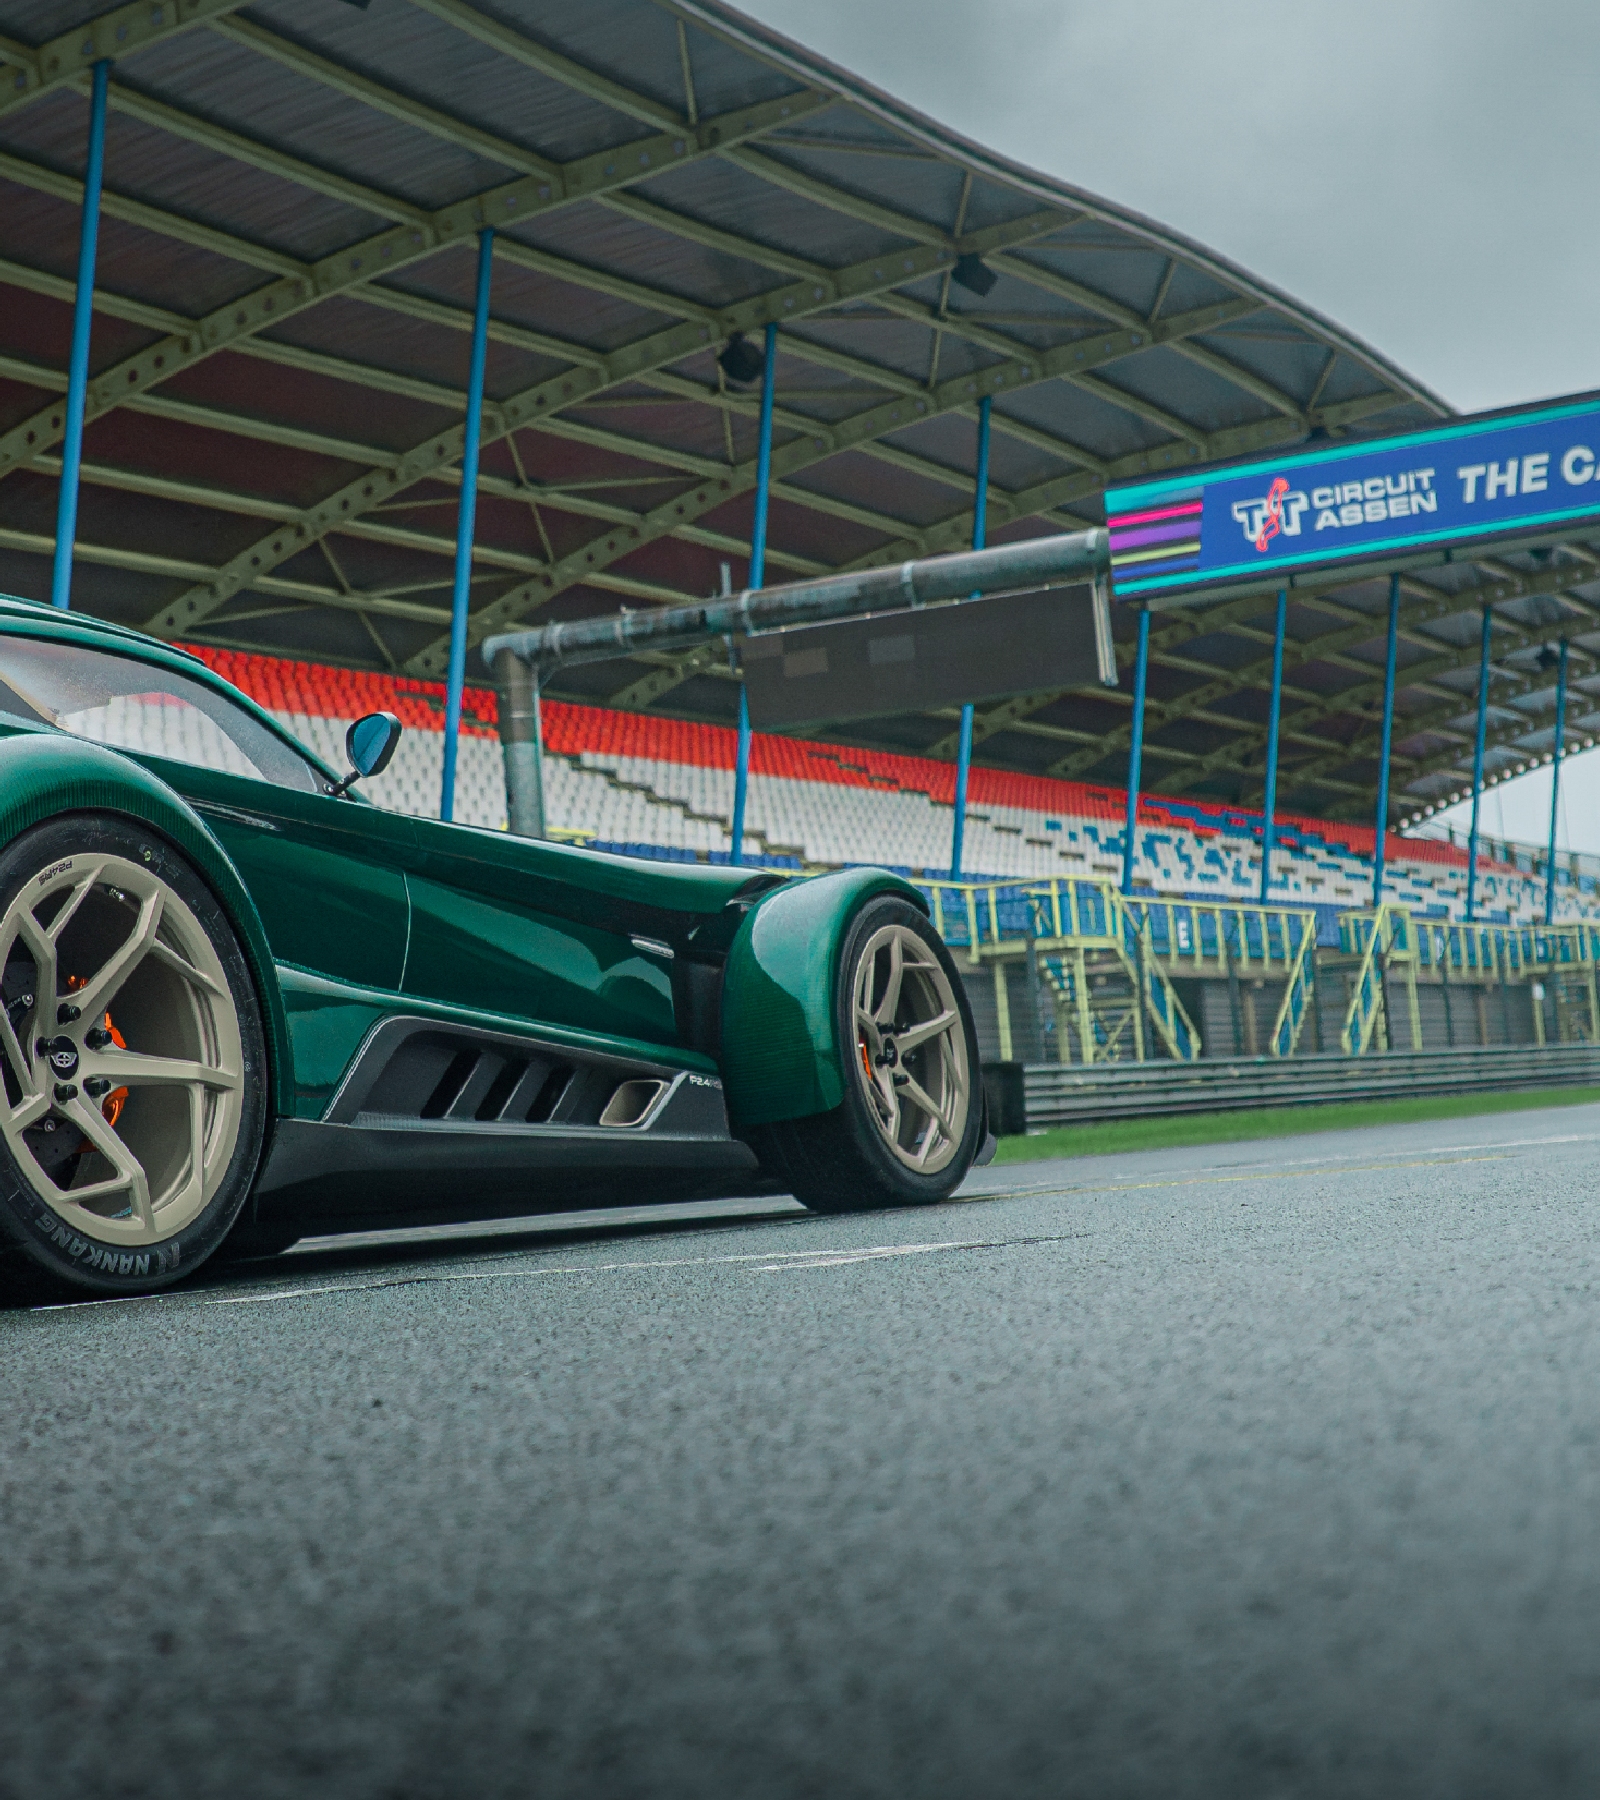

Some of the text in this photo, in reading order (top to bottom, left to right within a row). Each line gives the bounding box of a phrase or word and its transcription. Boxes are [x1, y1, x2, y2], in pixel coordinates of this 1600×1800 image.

[1311, 468, 1436, 509] CIRCUIT
[1457, 444, 1600, 504] THE C
[1314, 491, 1438, 531] ASSEN
[34, 1212, 150, 1276] NANKANG
